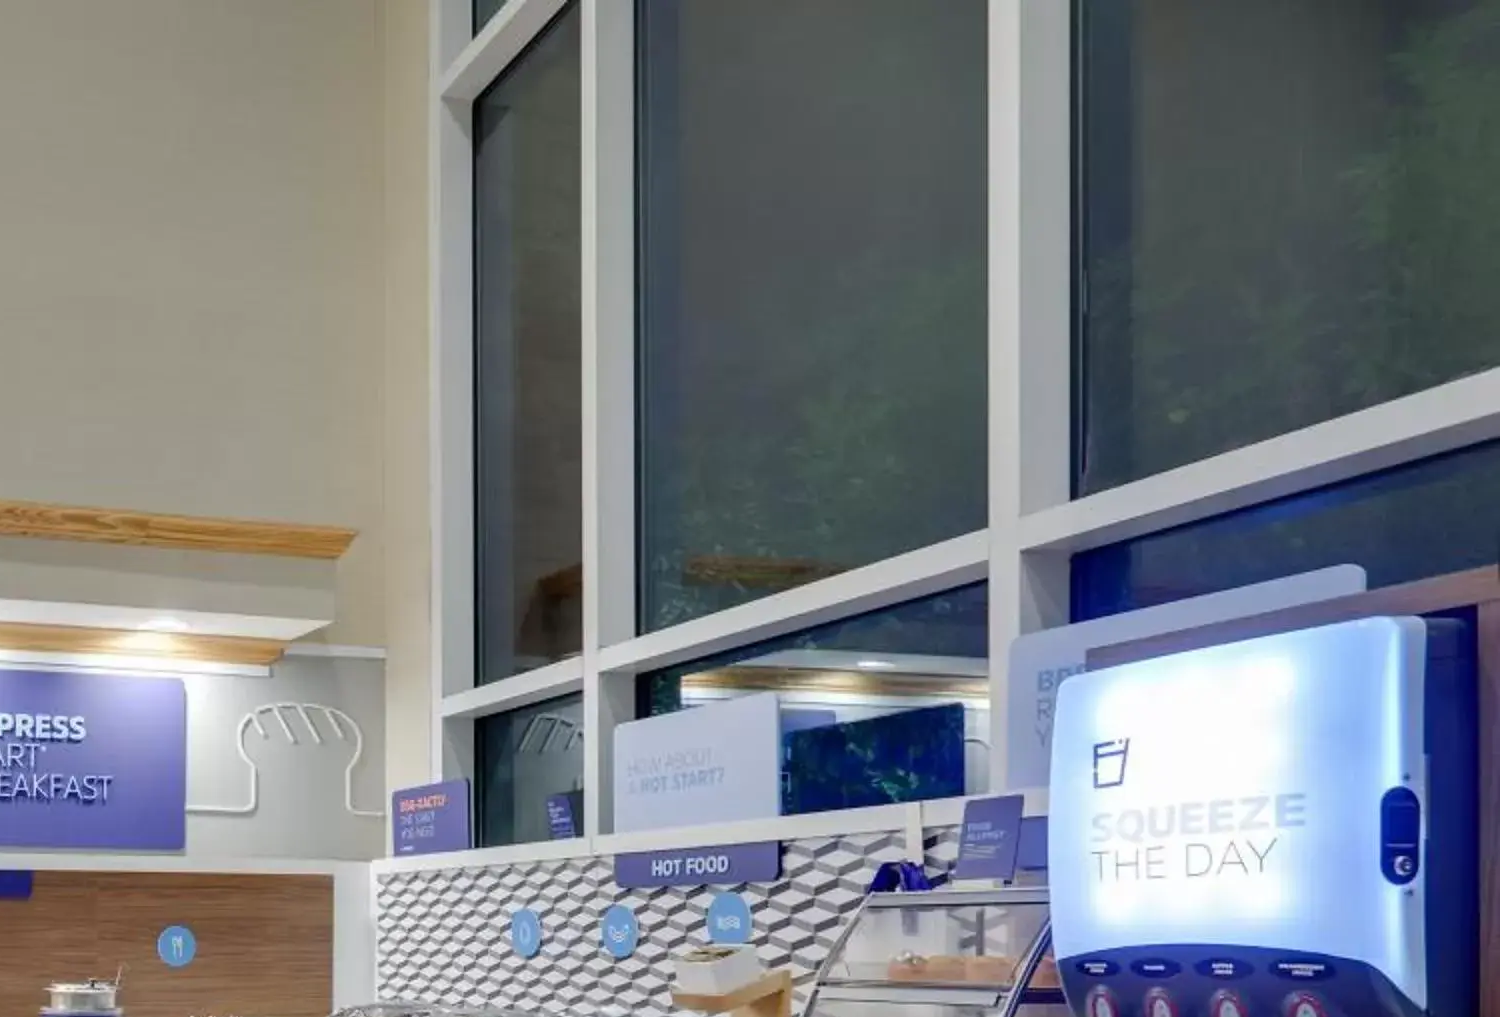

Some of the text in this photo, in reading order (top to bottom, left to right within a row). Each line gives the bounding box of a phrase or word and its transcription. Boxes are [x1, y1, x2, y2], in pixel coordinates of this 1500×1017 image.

[641, 776, 669, 794] HOT
[672, 766, 725, 792] START?
[1090, 793, 1306, 842] SQUEEZE
[651, 855, 729, 876] HOT FOOD
[1091, 838, 1278, 881] THE DAY
